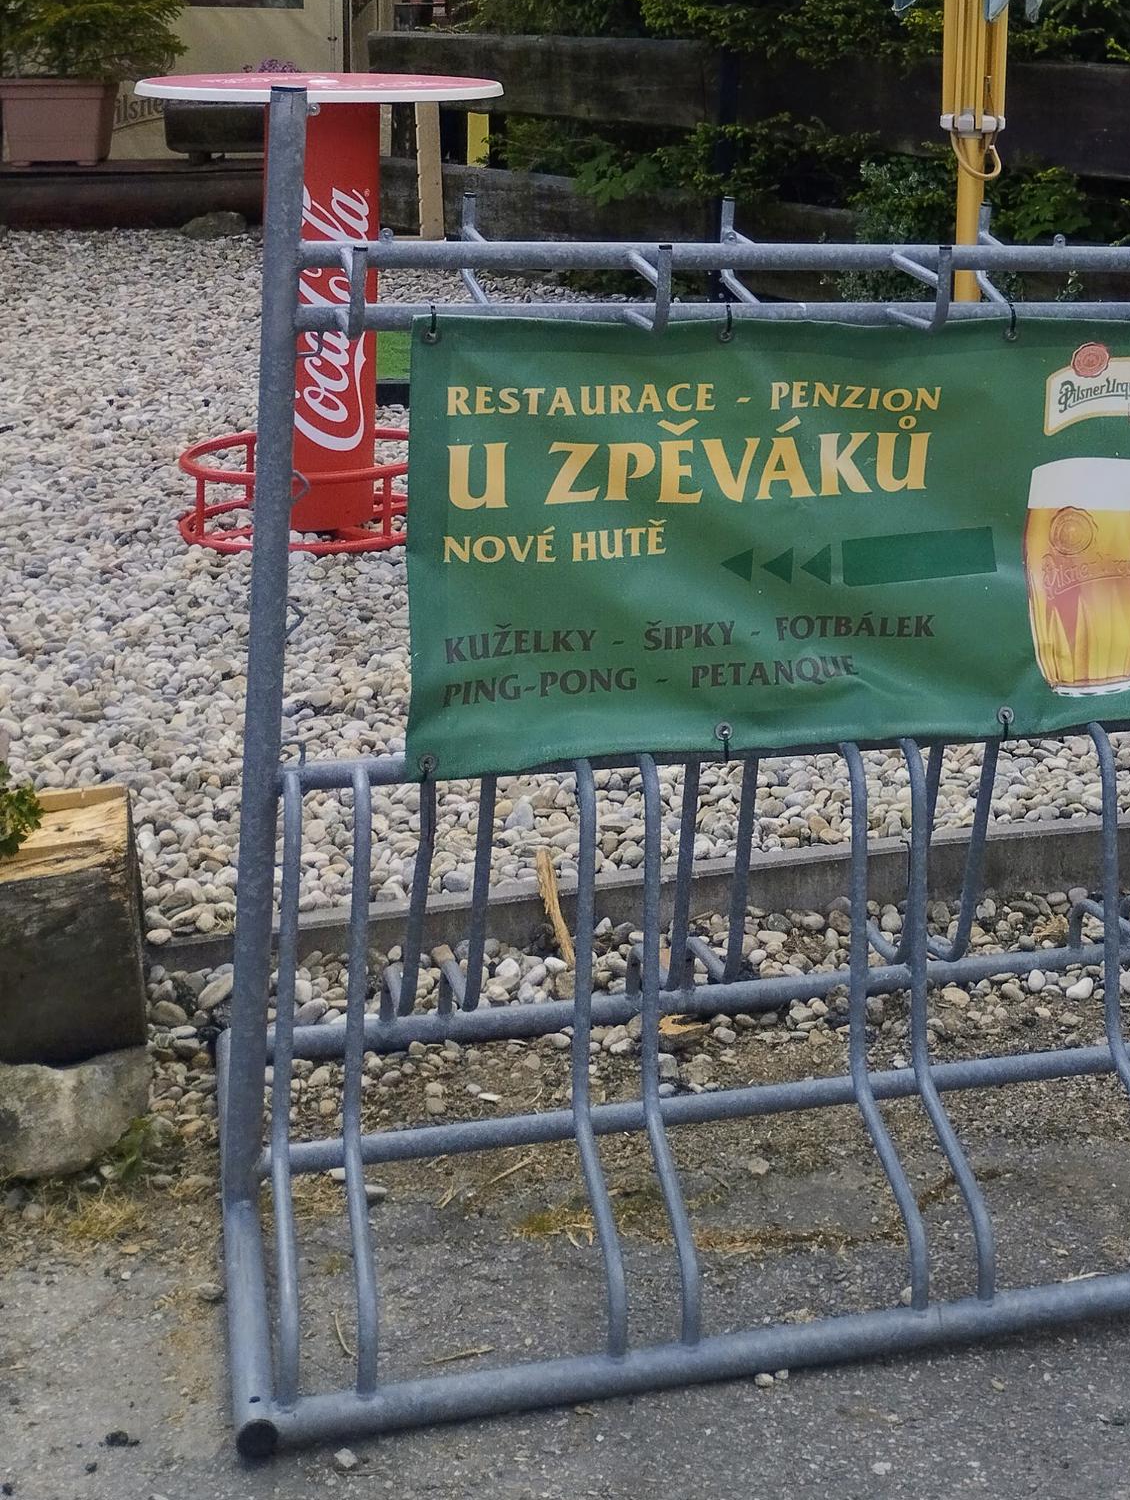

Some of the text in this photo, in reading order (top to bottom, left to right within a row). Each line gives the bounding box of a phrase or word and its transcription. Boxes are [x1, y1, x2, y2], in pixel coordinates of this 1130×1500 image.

[446, 382, 716, 417] RESTAURACE
[770, 380, 942, 412] PENZION
[1058, 379, 1106, 414] Pilsner
[446, 415, 932, 510] U ZPĚVÁKŮ
[443, 519, 668, 563] NOVÉ HUTĚ
[443, 622, 598, 665] KUŽELKY
[643, 619, 736, 652] ŠIPKY
[775, 611, 937, 641] FOTBÁLEK
[442, 667, 638, 709] PING-PONG
[691, 654, 860, 688] PETANQUE
